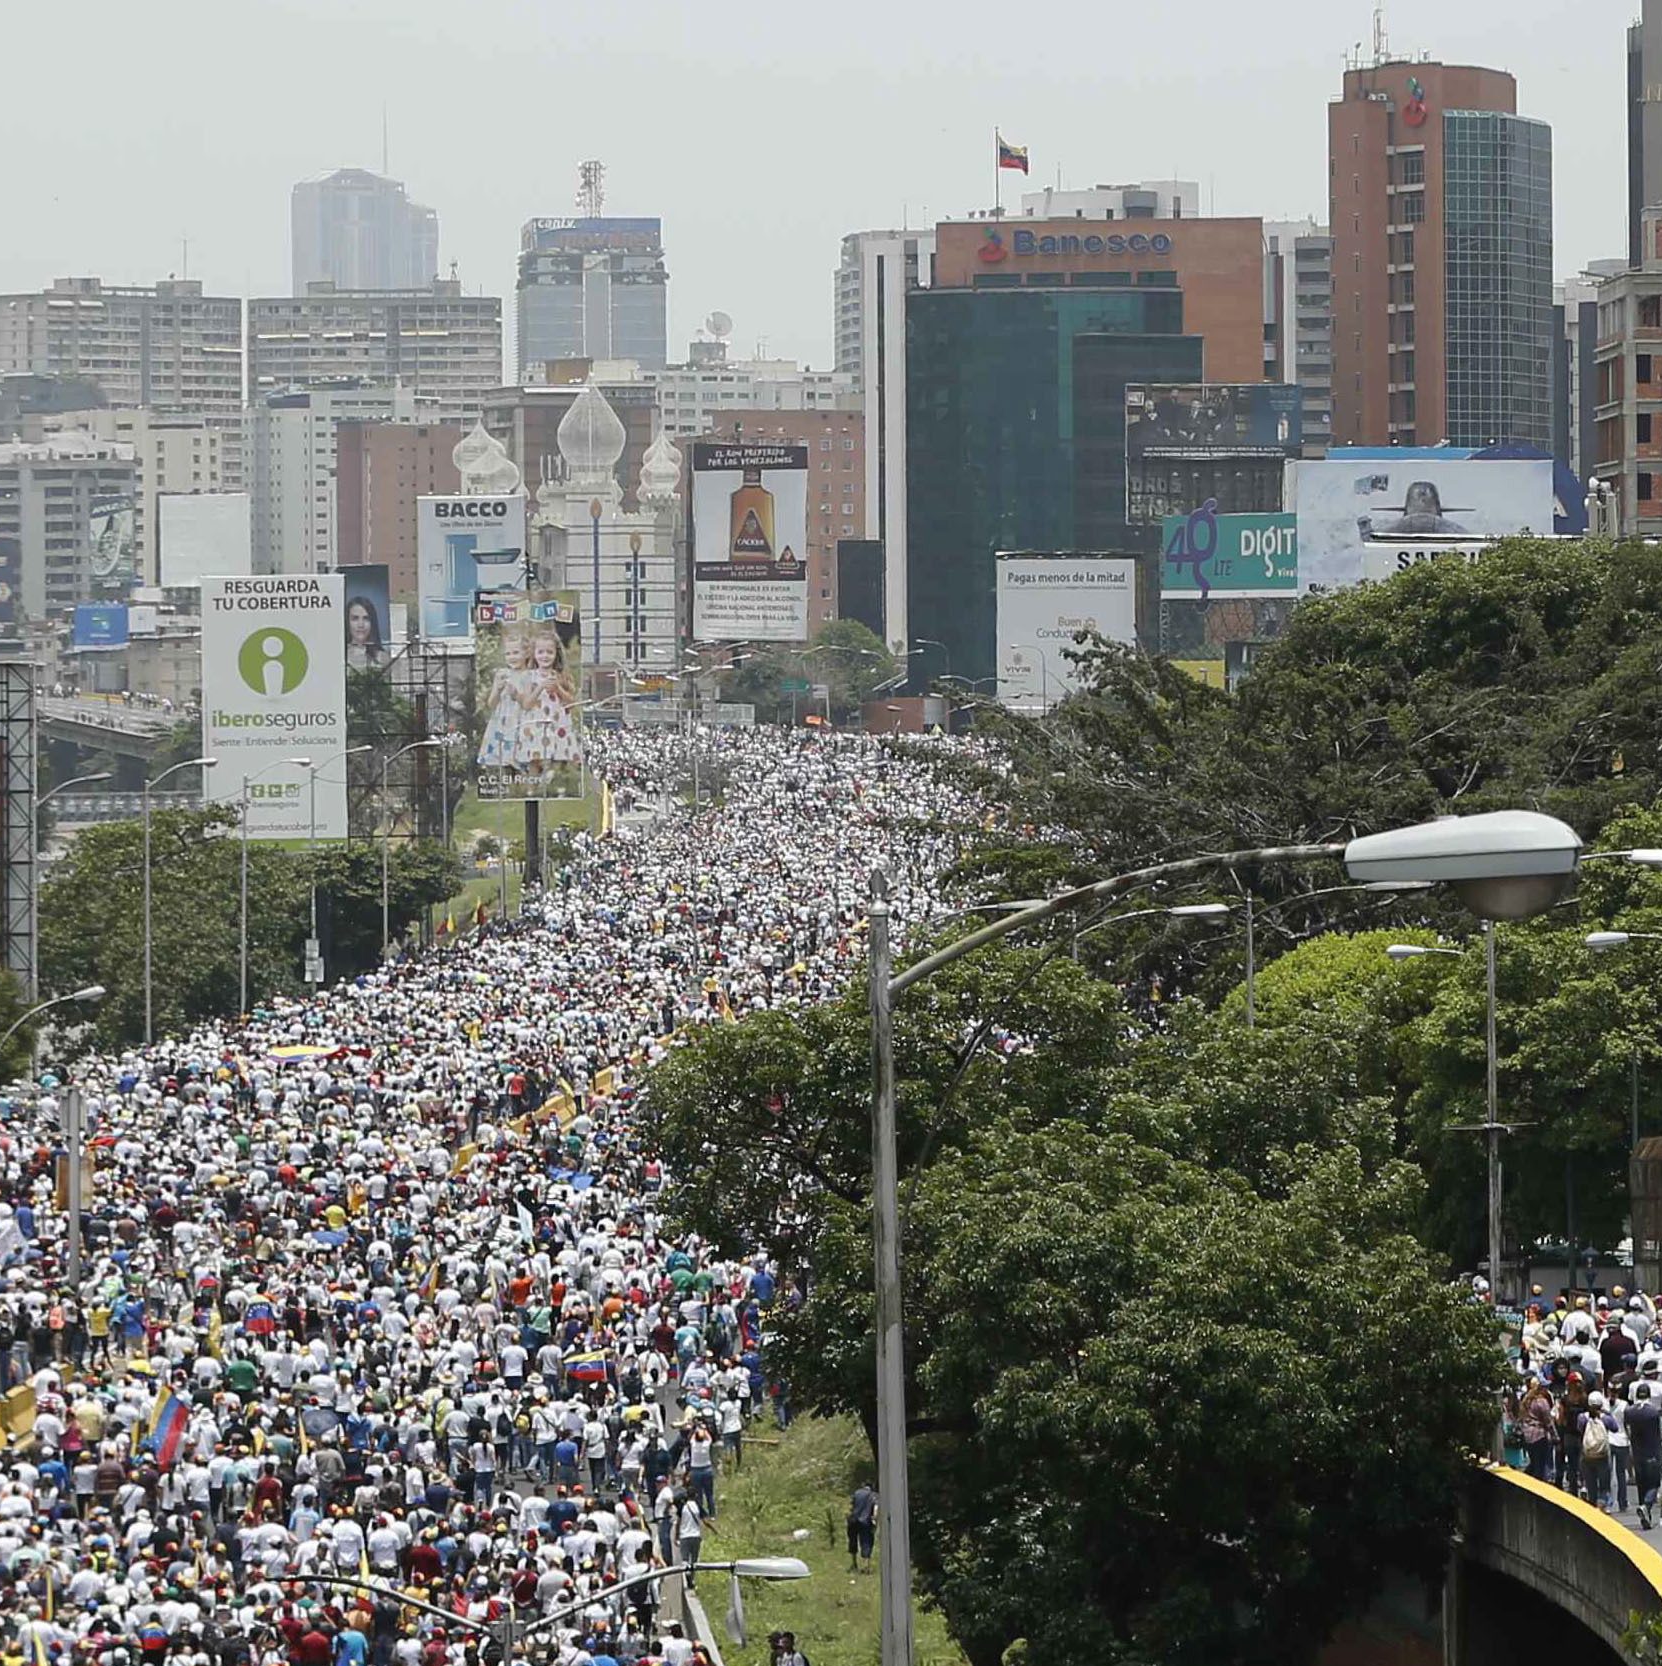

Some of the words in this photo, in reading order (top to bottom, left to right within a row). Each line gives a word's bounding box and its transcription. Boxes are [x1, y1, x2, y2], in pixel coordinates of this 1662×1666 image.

[1013, 229, 1171, 256] Banesco
[435, 502, 507, 517] BACCO
[1213, 560, 1233, 576] LTE
[1007, 572, 1036, 585] Pagas
[1038, 574, 1071, 583] menos
[1072, 571, 1084, 583] de
[1086, 571, 1096, 582] la
[1097, 571, 1126, 583] mitad
[224, 579, 320, 595] RESGUARDA
[213, 597, 234, 611] TU
[238, 595, 332, 610] COBERTURA
[1058, 616, 1082, 627] Buen
[211, 710, 337, 731] iberoseguros
